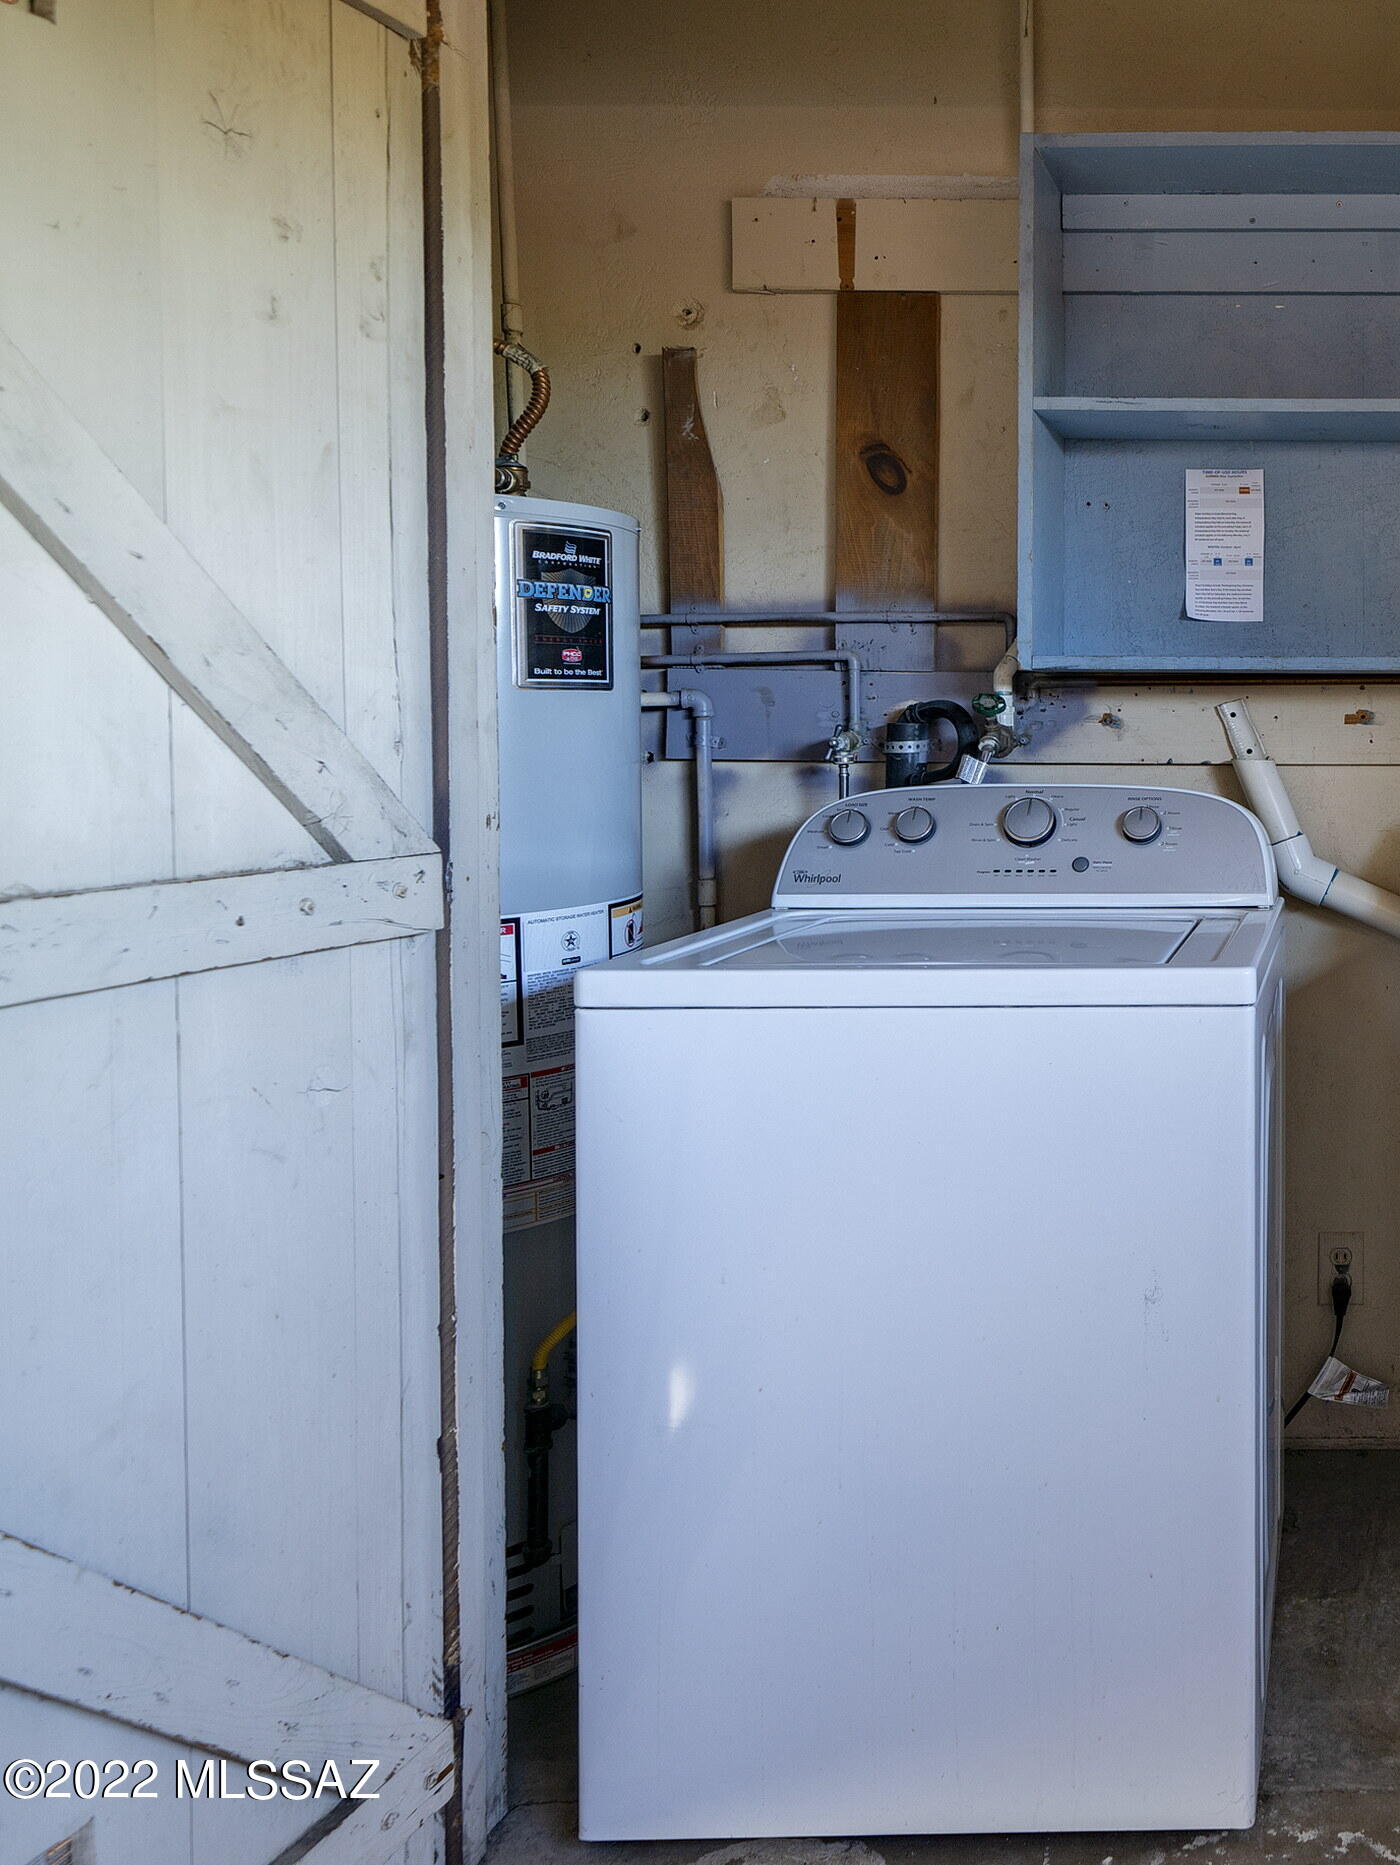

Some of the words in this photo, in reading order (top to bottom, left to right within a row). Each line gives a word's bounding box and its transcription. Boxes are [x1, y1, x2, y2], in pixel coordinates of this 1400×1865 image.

[532, 550, 577, 562] BRADFORD
[578, 554, 602, 565] WHITE
[518, 579, 611, 603] DEFENDER
[534, 603, 569, 613] SAFETY
[569, 605, 600, 615] SYSTEM
[534, 667, 552, 675] Built
[793, 872, 842, 885] Whirlpool
